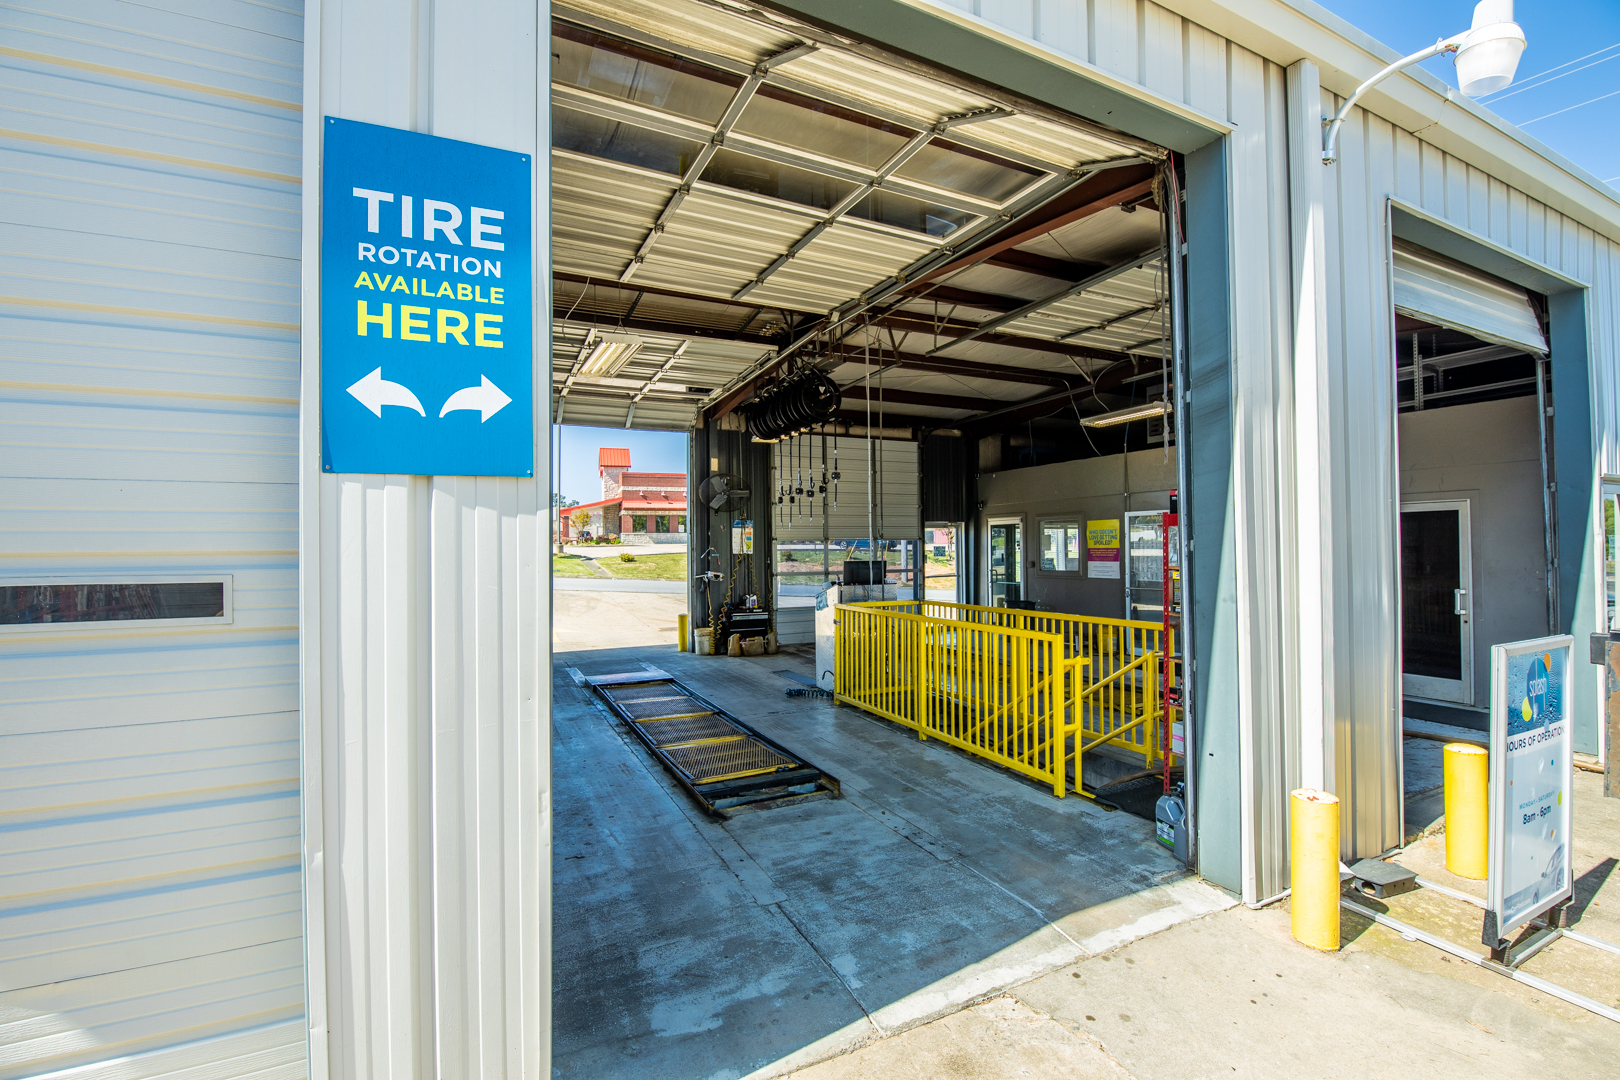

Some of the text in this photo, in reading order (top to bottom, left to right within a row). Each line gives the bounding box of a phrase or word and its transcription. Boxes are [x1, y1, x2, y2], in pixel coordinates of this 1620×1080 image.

[353, 187, 504, 251] TIRE
[358, 242, 501, 278] ROTATION
[354, 271, 504, 304] AVAILABLE
[357, 300, 503, 348] HERE
[1527, 734, 1536, 747] OF
[1519, 799, 1536, 810] MONDAY
[1538, 790, 1555, 803] SATURDAY
[1523, 813, 1536, 825] 8am
[1540, 805, 1552, 818] 6pm
